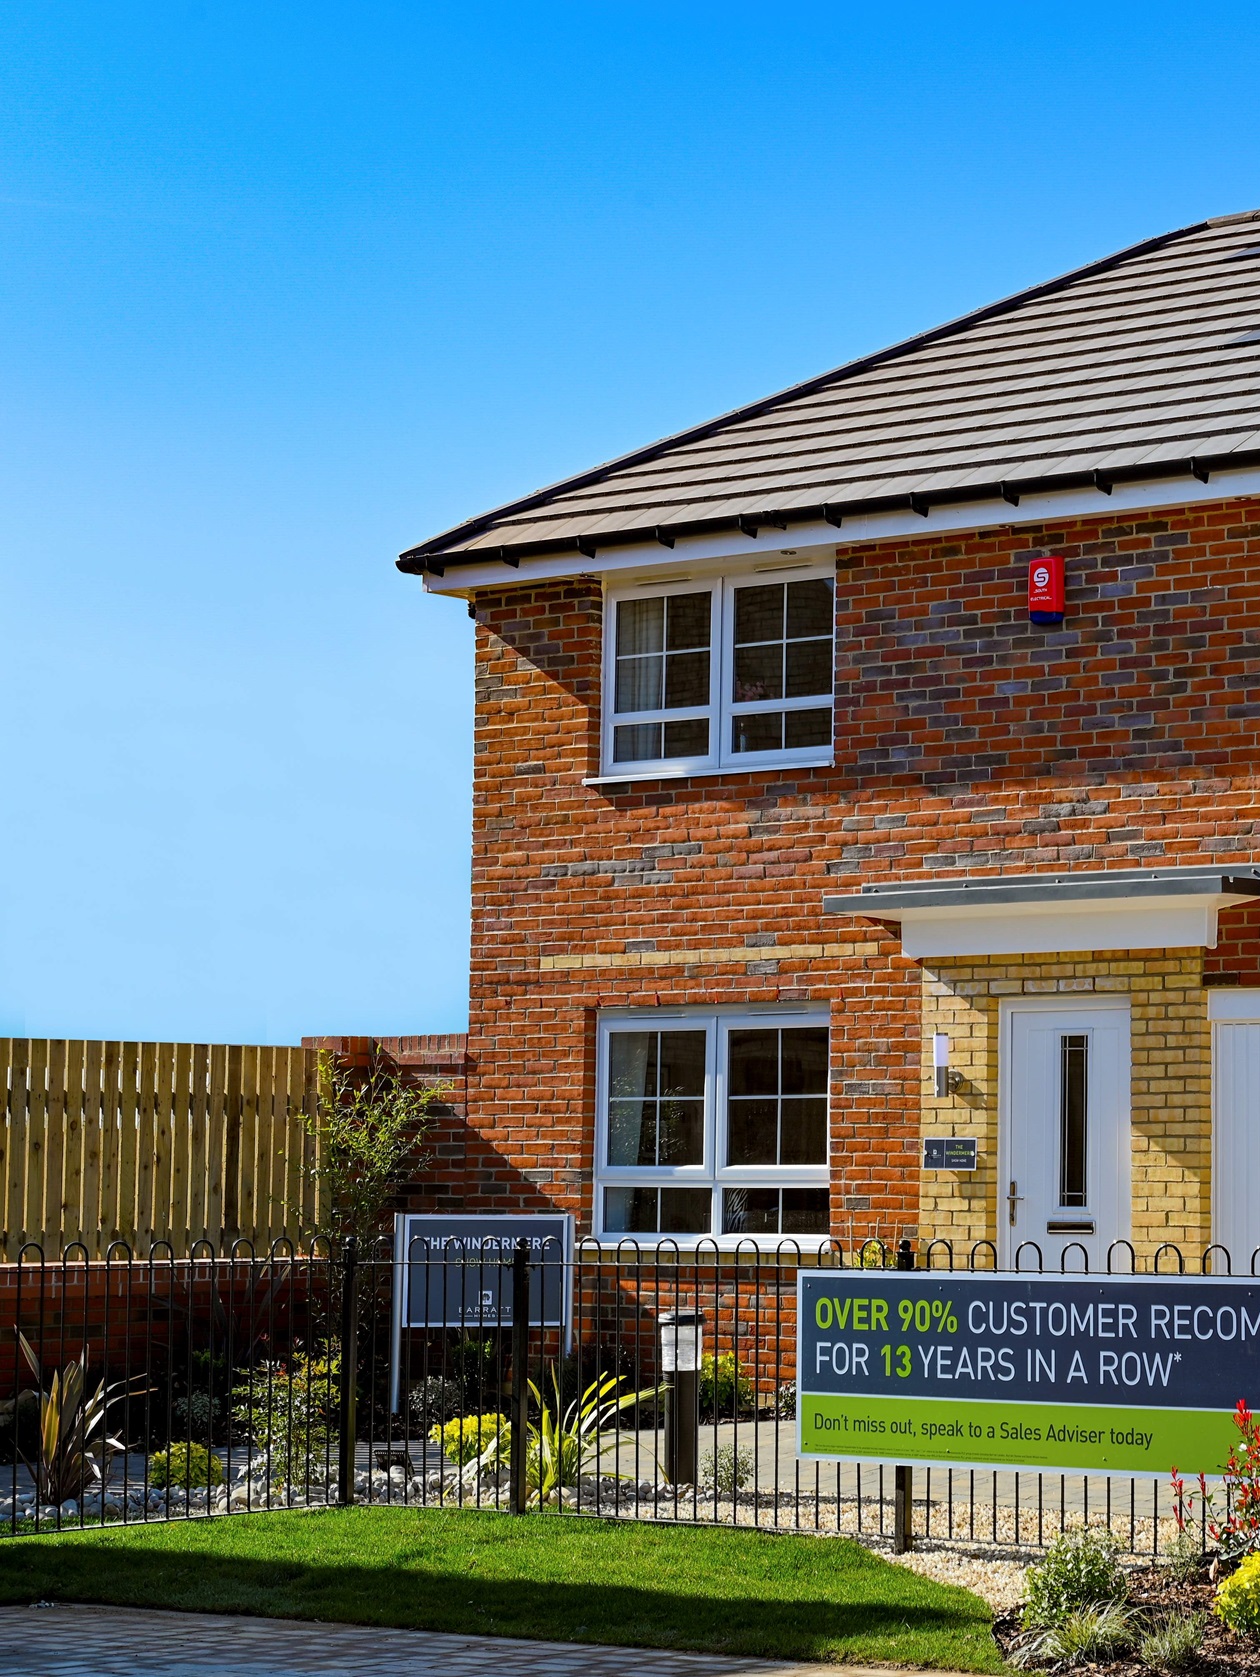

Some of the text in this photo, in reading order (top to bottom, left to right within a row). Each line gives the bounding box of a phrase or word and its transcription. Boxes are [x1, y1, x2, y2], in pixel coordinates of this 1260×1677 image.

[815, 1297, 889, 1331] OVER
[898, 1299, 958, 1333] 90%
[968, 1300, 1138, 1338] CUSTOMER
[816, 1341, 870, 1376] FOR
[880, 1344, 912, 1378] 13
[918, 1345, 1015, 1381] YEARS
[1026, 1348, 1056, 1382] IN
[1066, 1350, 1088, 1384] A
[813, 1413, 1153, 1450] Don't miss out, speak to a Sales Adviser today
